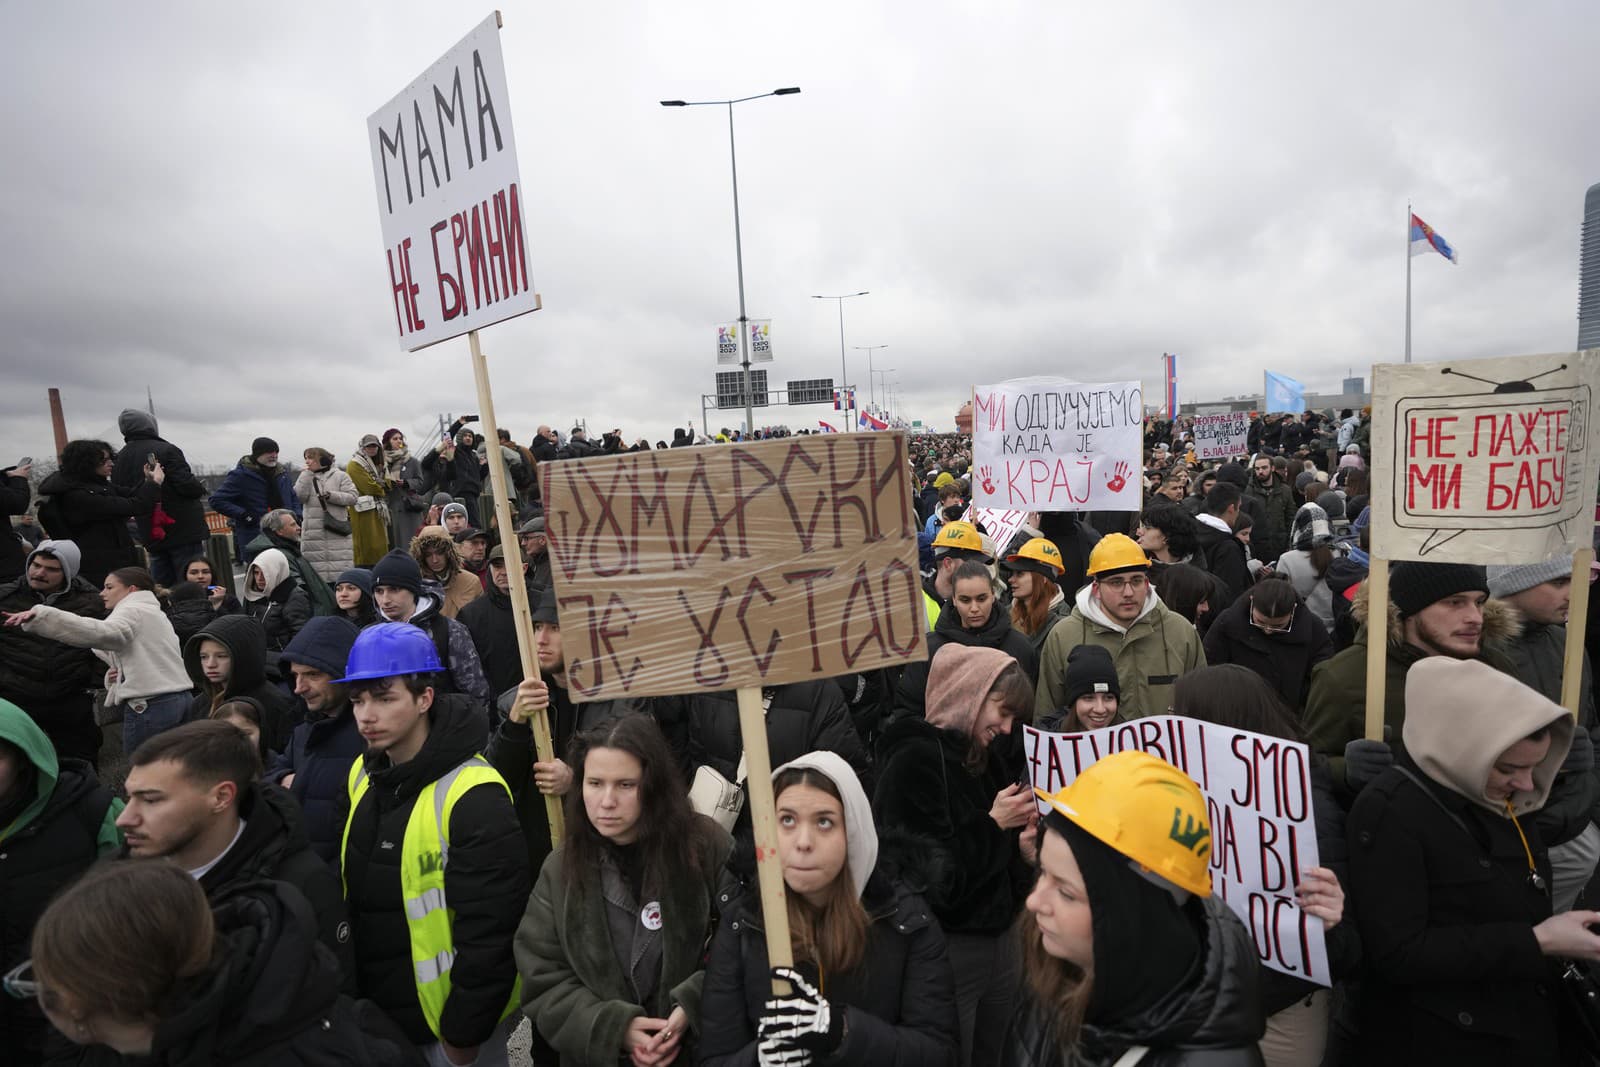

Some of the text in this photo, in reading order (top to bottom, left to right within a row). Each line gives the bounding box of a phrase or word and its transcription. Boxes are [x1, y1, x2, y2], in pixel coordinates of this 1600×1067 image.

[378, 49, 503, 214] МАМА
[387, 183, 529, 336] НЕ БРИНИ
[975, 388, 1142, 432] МИ ОДЛУЧУЈЕМО
[1409, 416, 1458, 459] НЕ
[1002, 433, 1094, 455] КАДА ЈЕ
[1217, 437, 1231, 446] ИЗ
[1006, 455, 1093, 505] КРАЈ
[1408, 455, 1565, 511] МИ БАБУ
[559, 556, 921, 698] ЈЕ УСТАО
[1231, 734, 1309, 823] SMO
[1258, 815, 1300, 893] BI
